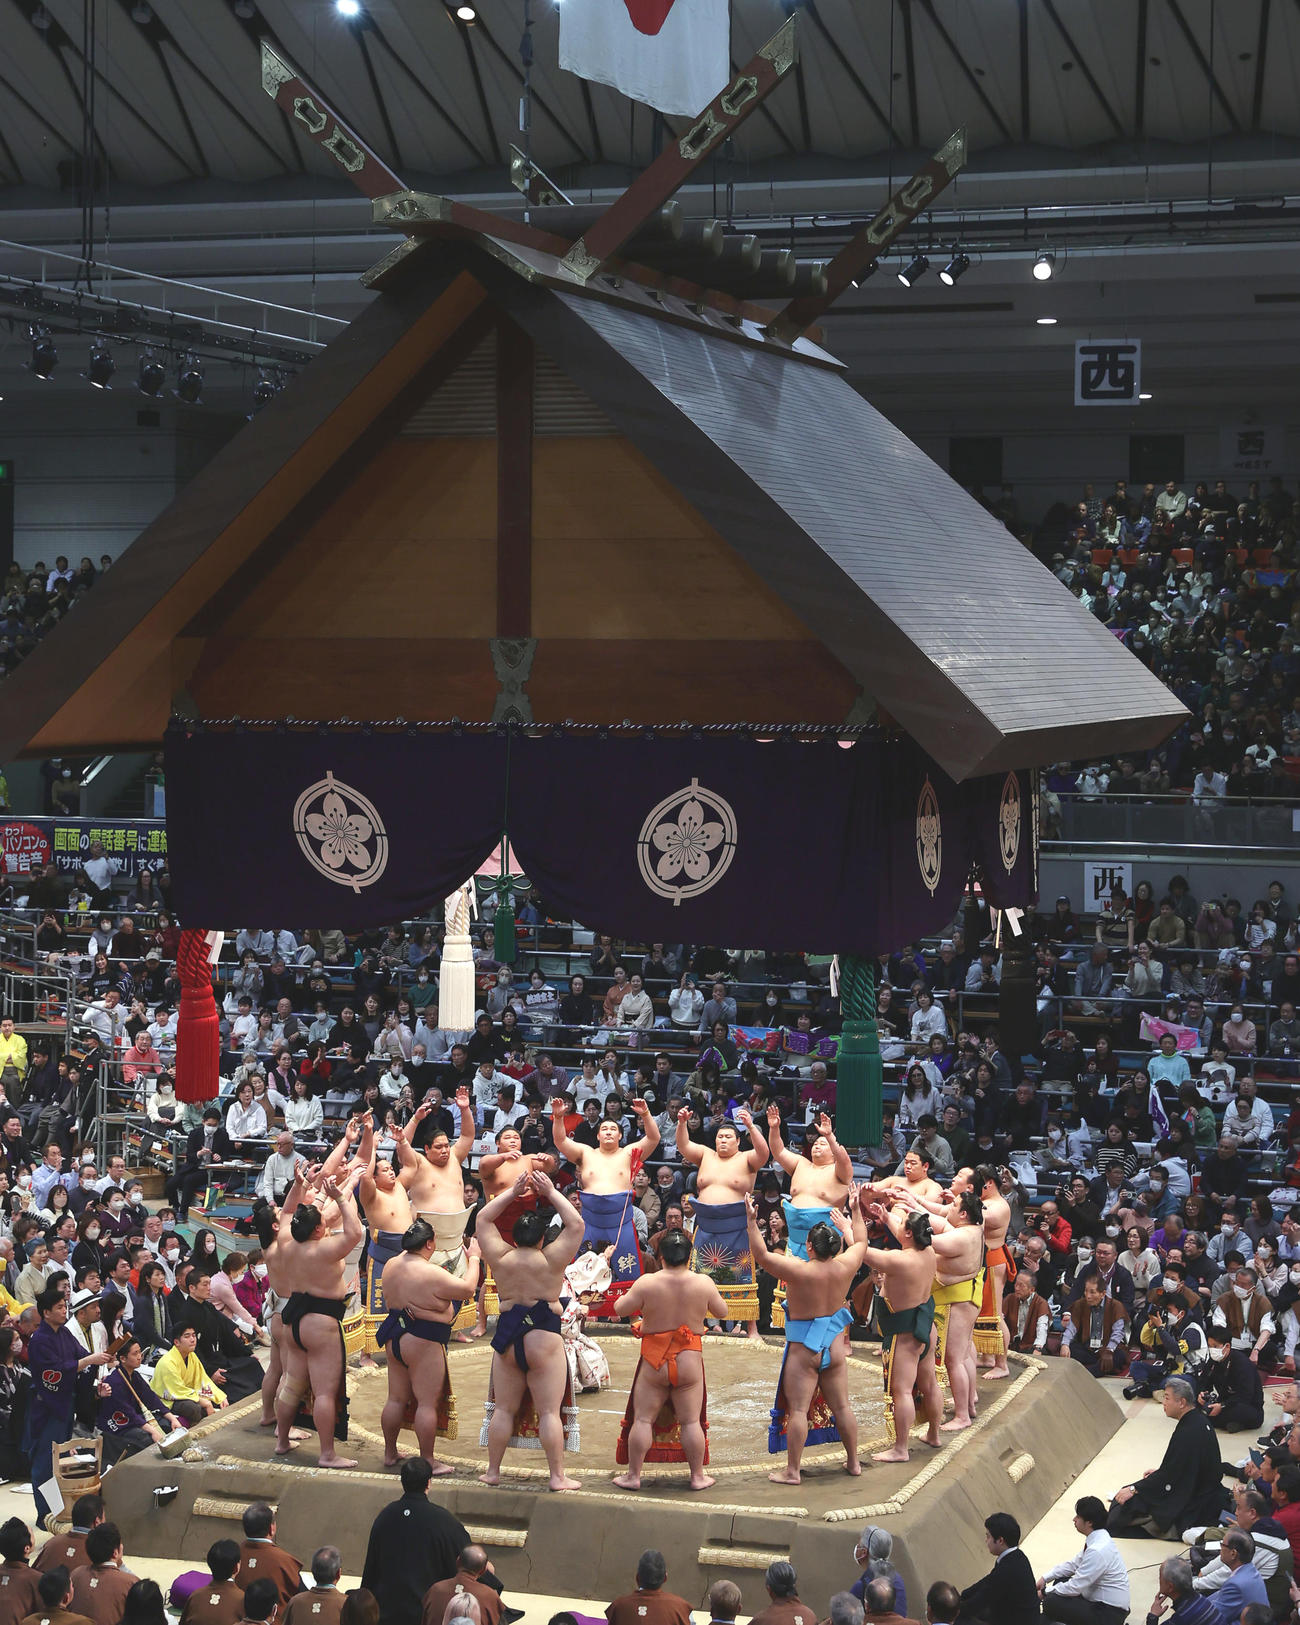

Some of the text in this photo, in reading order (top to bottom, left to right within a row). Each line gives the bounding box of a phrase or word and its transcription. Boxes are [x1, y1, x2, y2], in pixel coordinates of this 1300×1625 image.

[1079, 345, 1137, 399] 西
[1237, 431, 1265, 456] 西
[5, 835, 48, 852] パソコンの
[1092, 866, 1125, 901] 西
[617, 1252, 638, 1274] 絆
